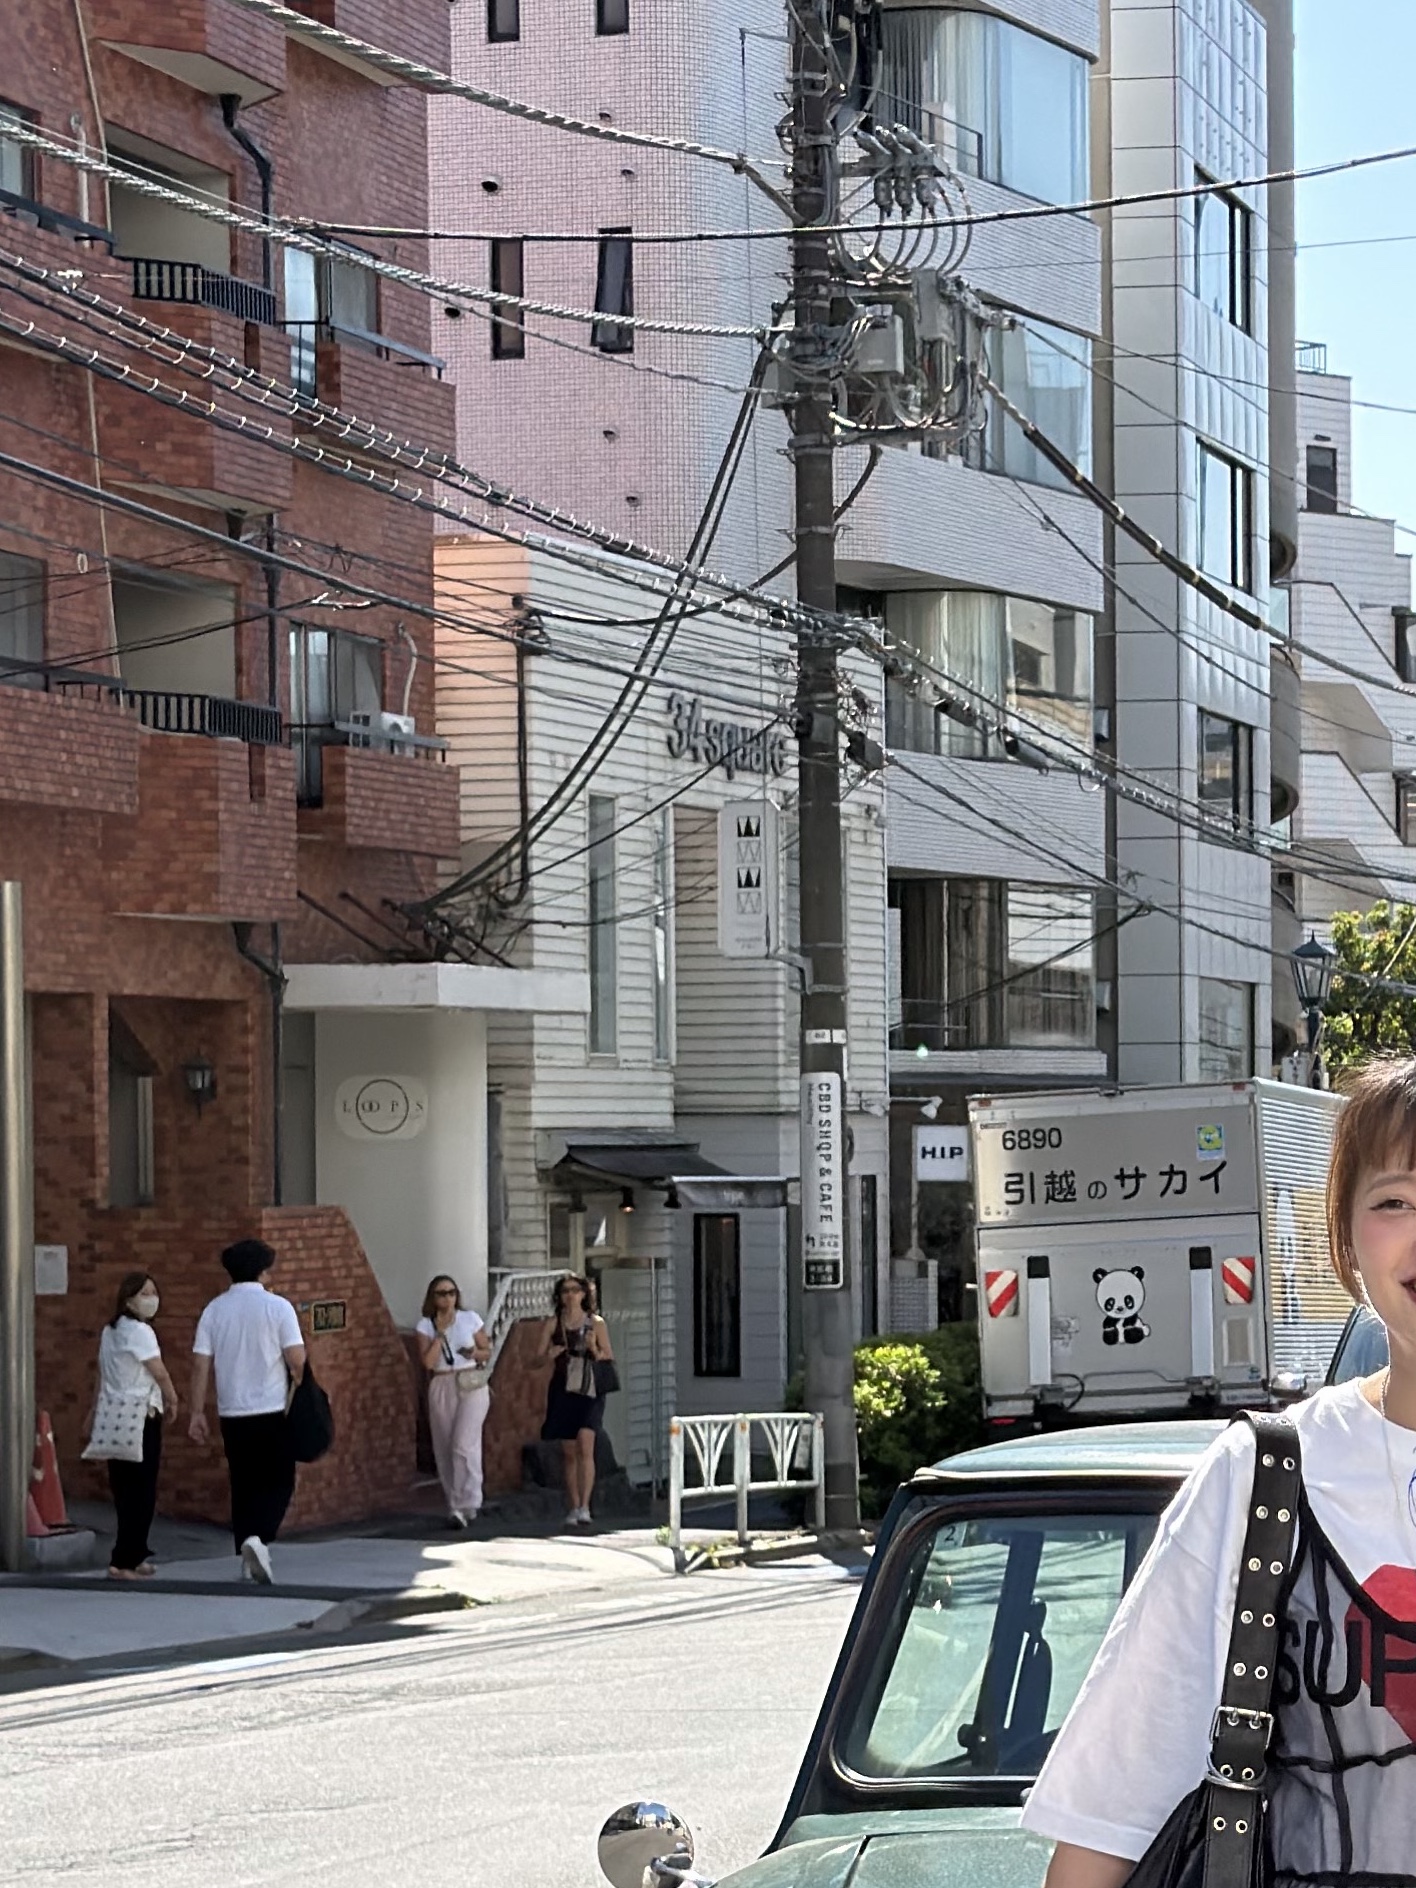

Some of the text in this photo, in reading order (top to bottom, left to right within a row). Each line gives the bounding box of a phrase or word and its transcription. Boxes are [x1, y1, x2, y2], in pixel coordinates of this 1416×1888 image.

[818, 1082, 832, 1113] CBD
[1001, 1127, 1063, 1151] 6890
[1004, 1160, 1228, 1206] 引越のサカイ
[819, 1184, 833, 1223] CAFE
